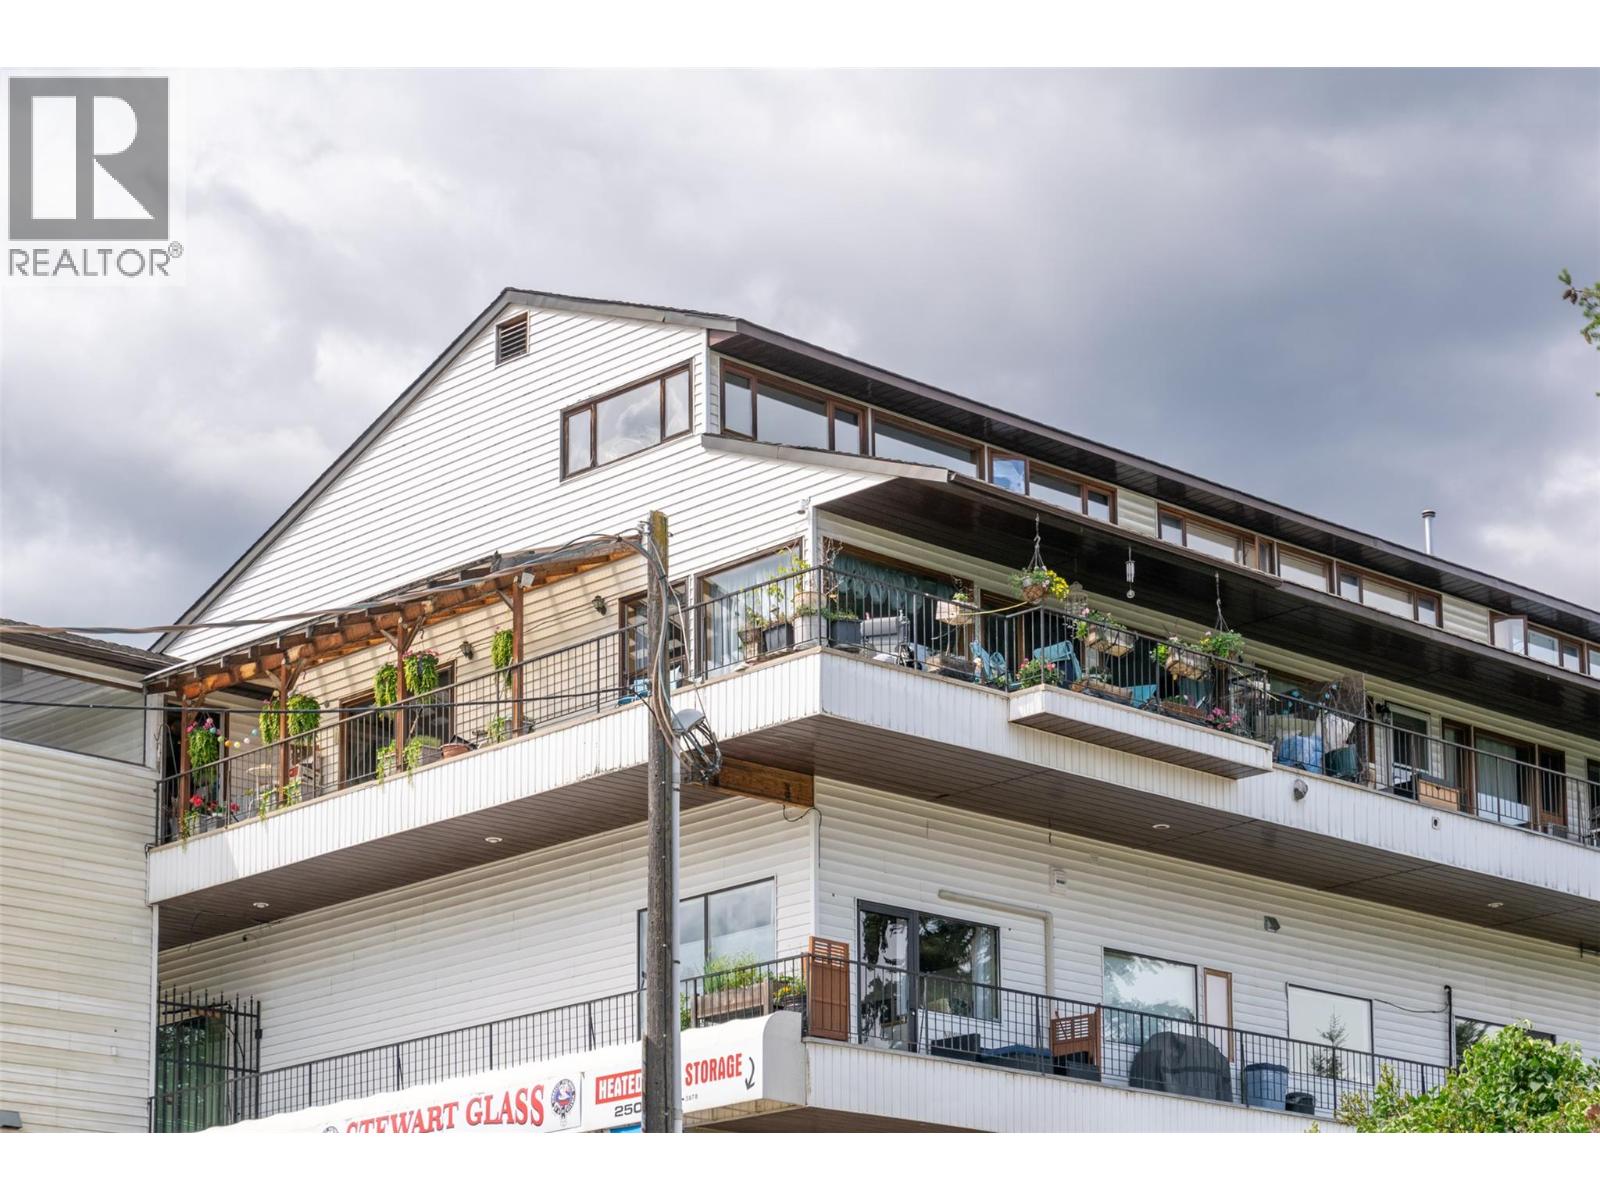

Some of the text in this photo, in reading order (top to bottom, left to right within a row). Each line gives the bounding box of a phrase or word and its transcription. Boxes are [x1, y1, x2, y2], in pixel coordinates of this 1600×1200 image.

[599, 1052, 743, 1100] HEATED STORAGE
[465, 1084, 545, 1127] GLASS
[614, 1102, 642, 1118] 250
